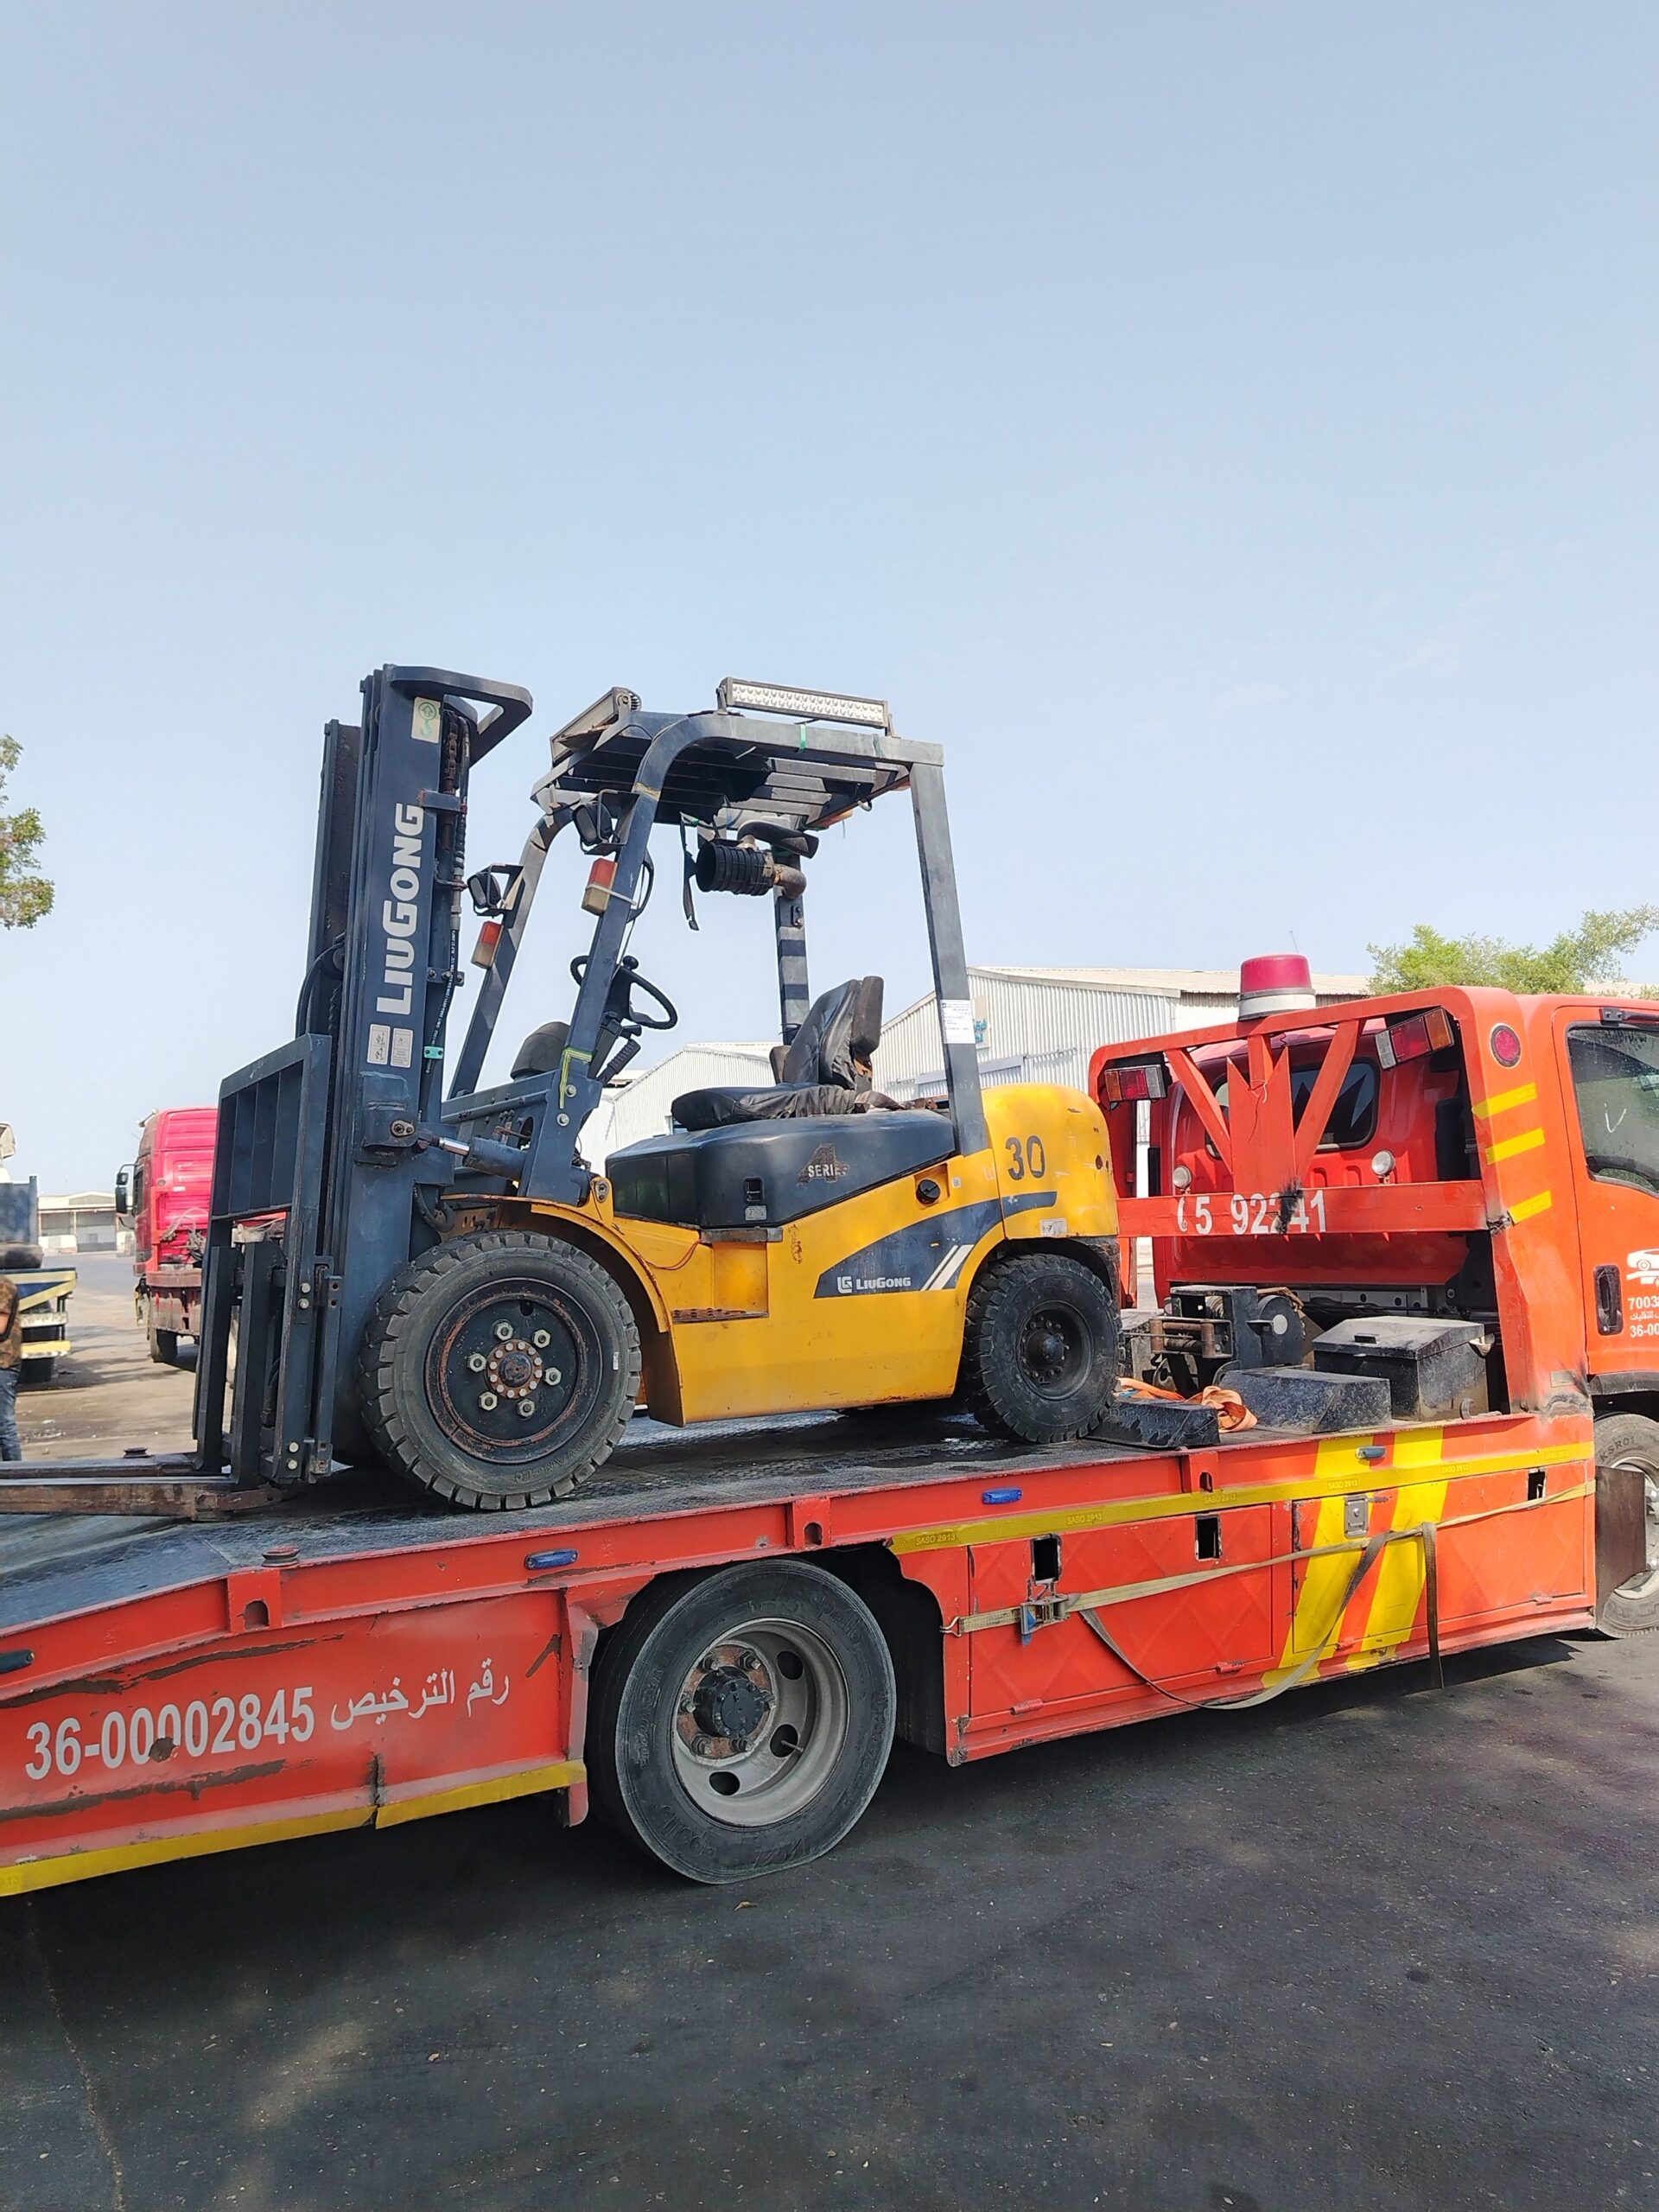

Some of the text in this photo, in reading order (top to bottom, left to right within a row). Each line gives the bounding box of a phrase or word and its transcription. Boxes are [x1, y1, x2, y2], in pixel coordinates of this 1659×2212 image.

[377, 803, 424, 1014] LIUGONG
[1006, 1135, 1045, 1180] 30
[1627, 1295, 1659, 1311] 7003
[1203, 1495, 1220, 1504] SASO
[1066, 1515, 1085, 1525] SASO
[916, 1533, 956, 1546] SASO 2913
[25, 1657, 510, 1780] رقم الترخيص 36-00002845
